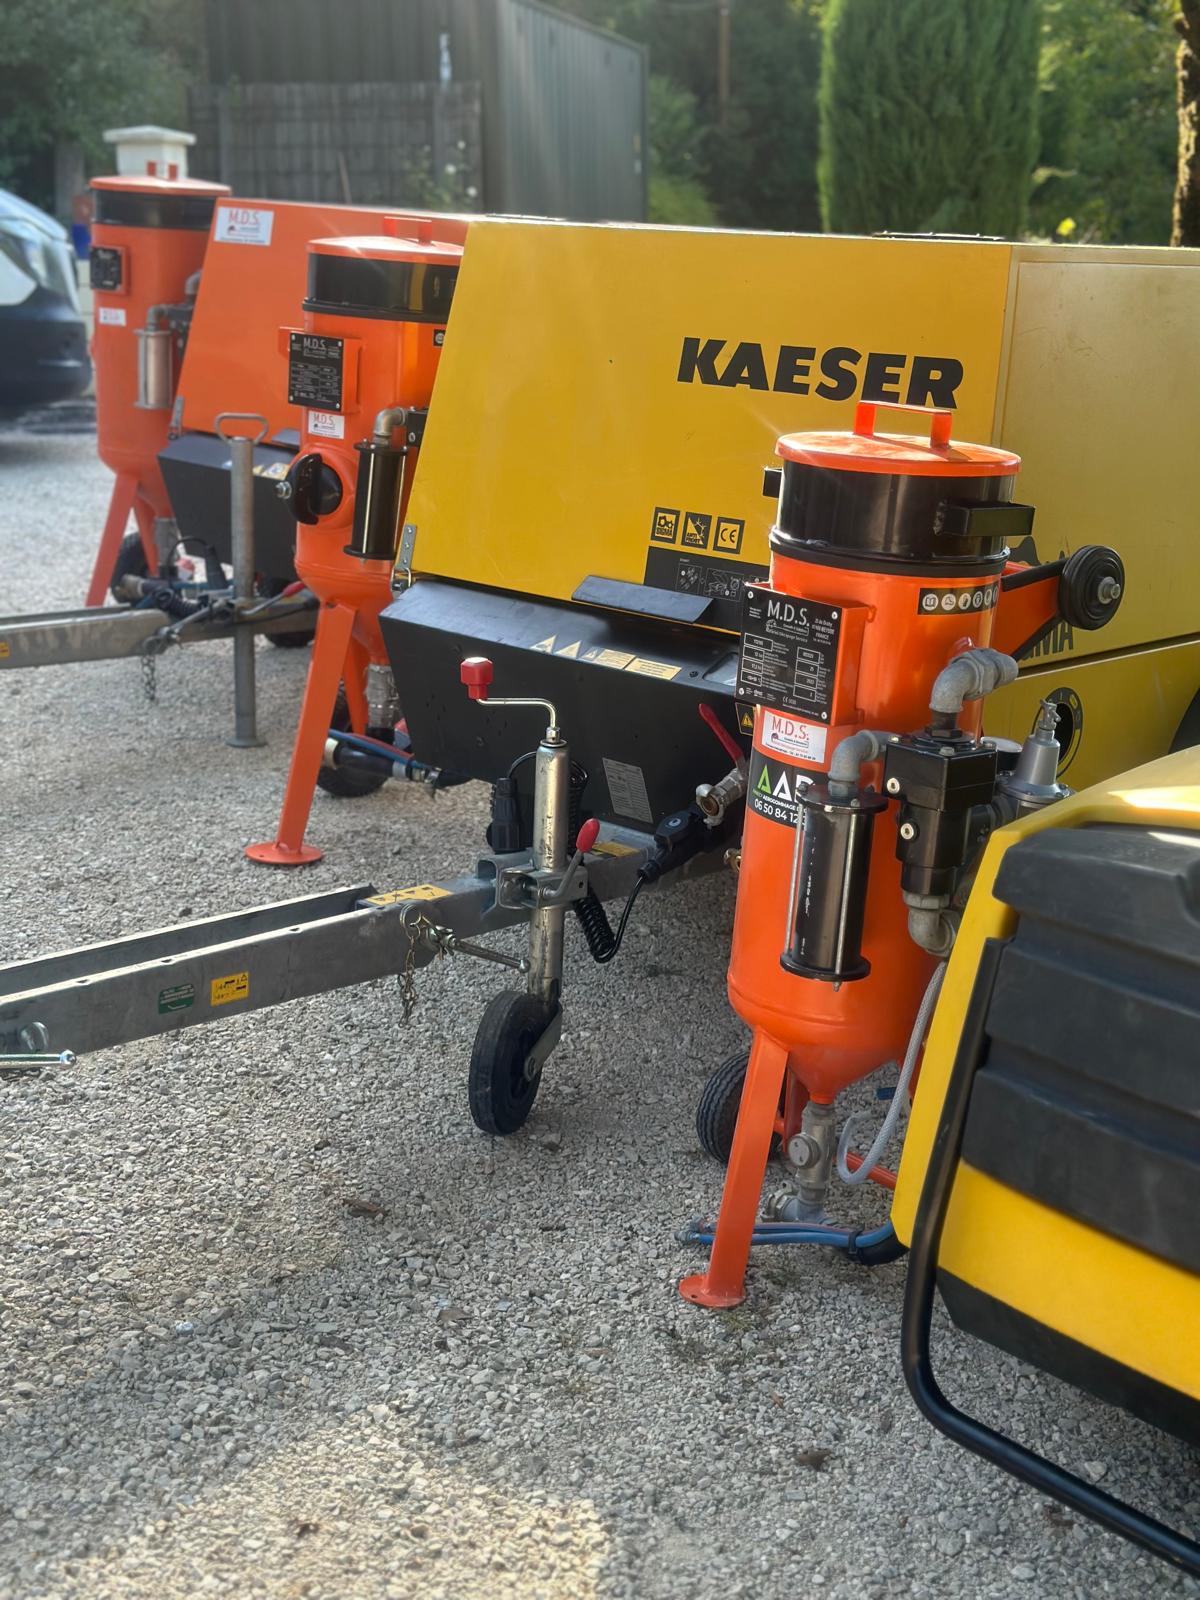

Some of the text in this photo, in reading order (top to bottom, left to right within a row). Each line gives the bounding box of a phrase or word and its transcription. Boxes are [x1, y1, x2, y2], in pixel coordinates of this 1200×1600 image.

[677, 337, 964, 409] KAESER
[720, 528, 737, 544] CE
[767, 600, 810, 627] M.D.S.
[772, 716, 809, 741] M.D.S.
[754, 798, 763, 811] 06
[763, 802, 774, 815] 50
[774, 807, 788, 821] 84
